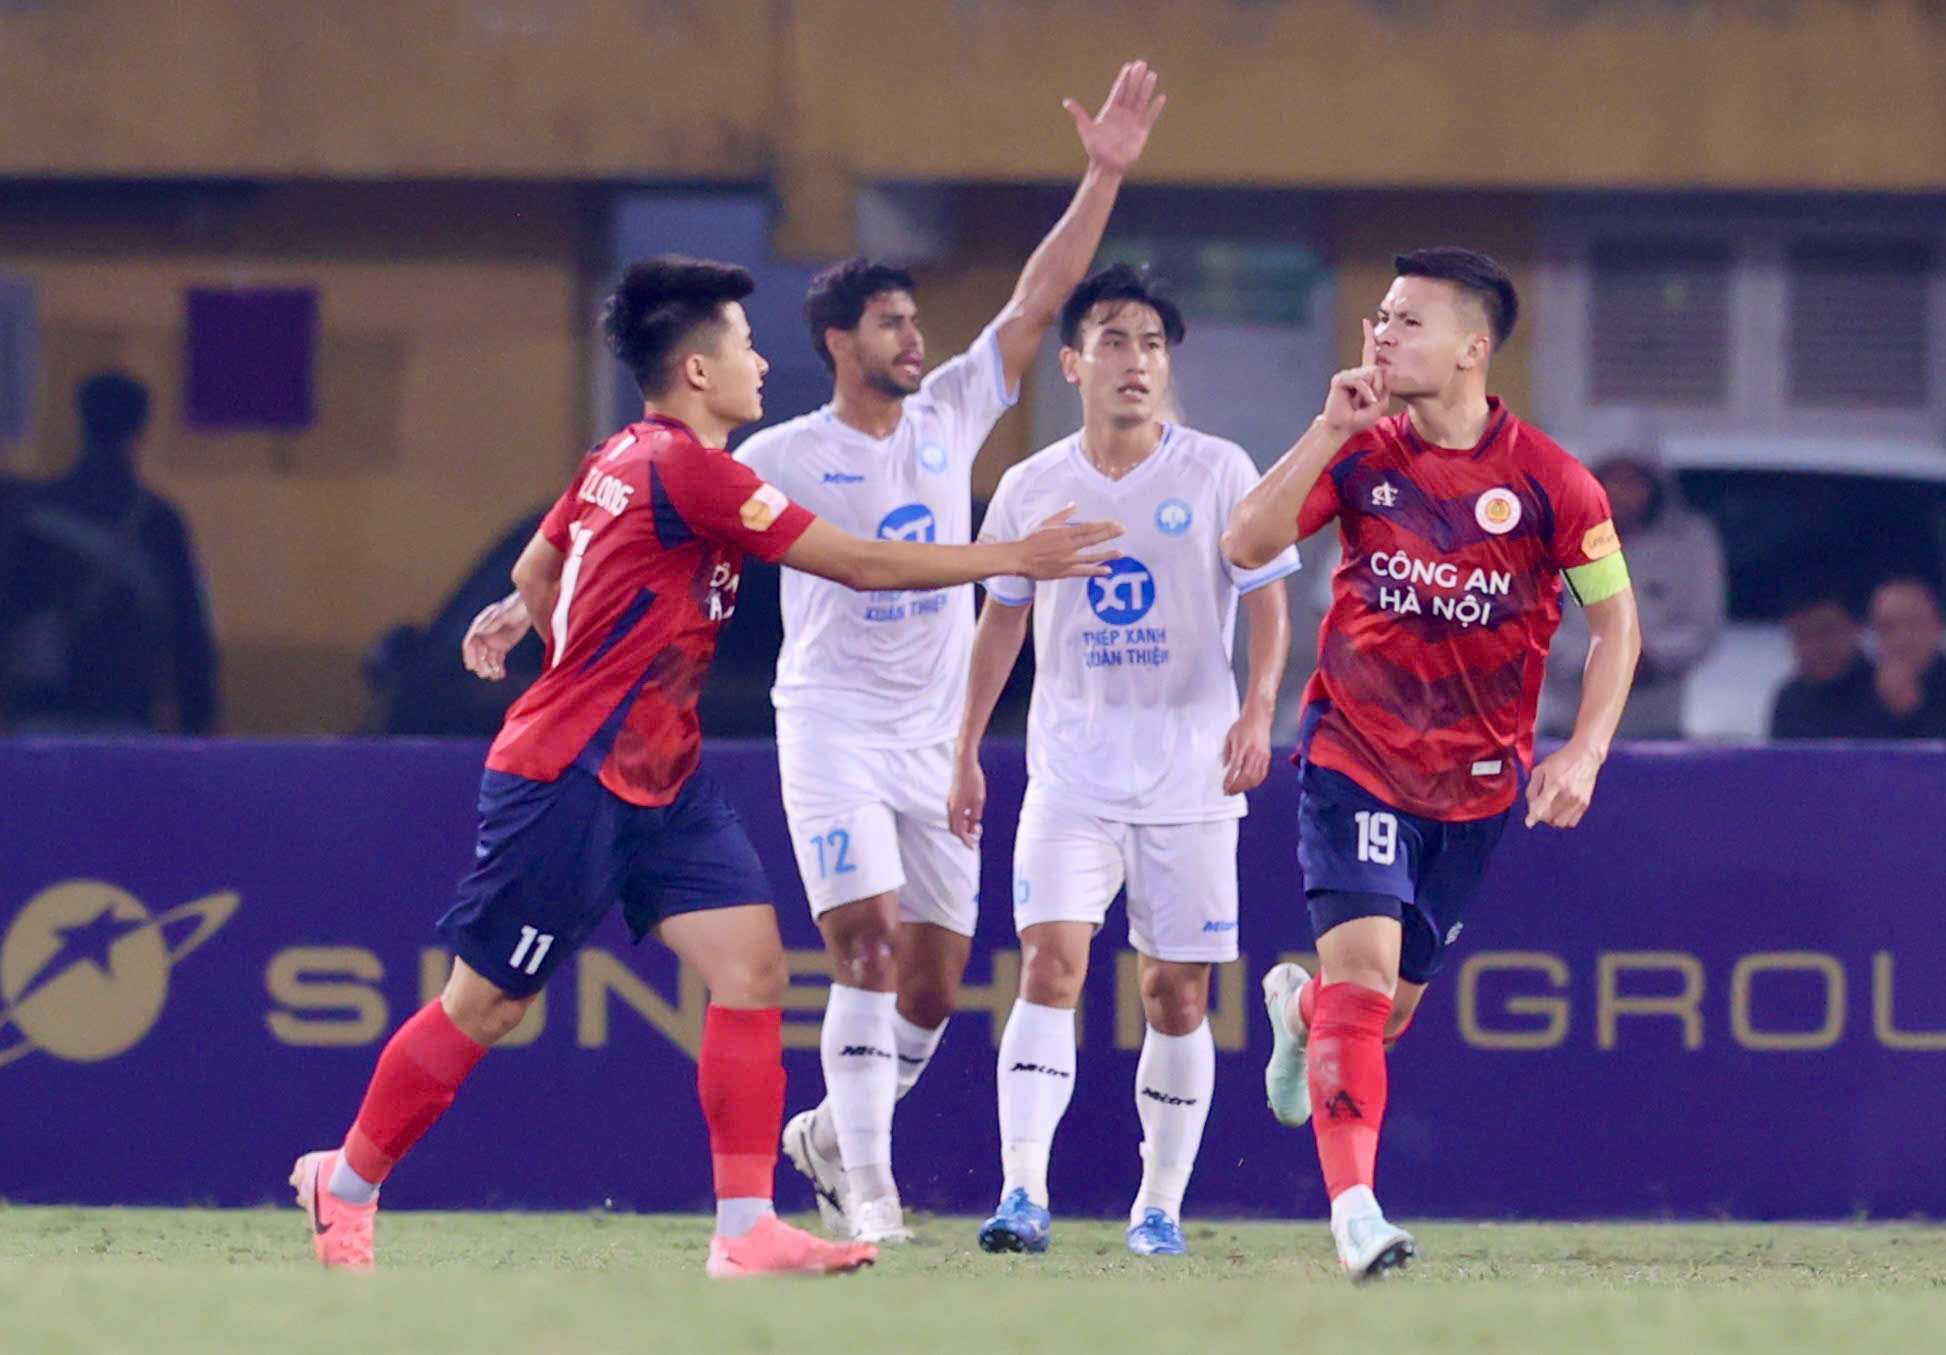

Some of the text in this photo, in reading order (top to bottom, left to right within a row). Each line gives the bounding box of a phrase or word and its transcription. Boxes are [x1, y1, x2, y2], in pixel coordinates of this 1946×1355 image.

[1093, 572, 1150, 614] XT
[1370, 550, 1511, 596] CÔNG AN
[1379, 585, 1491, 629] HÀ NỘI
[810, 829, 858, 878] 12
[1354, 810, 1398, 866] 19
[509, 924, 554, 975] 11
